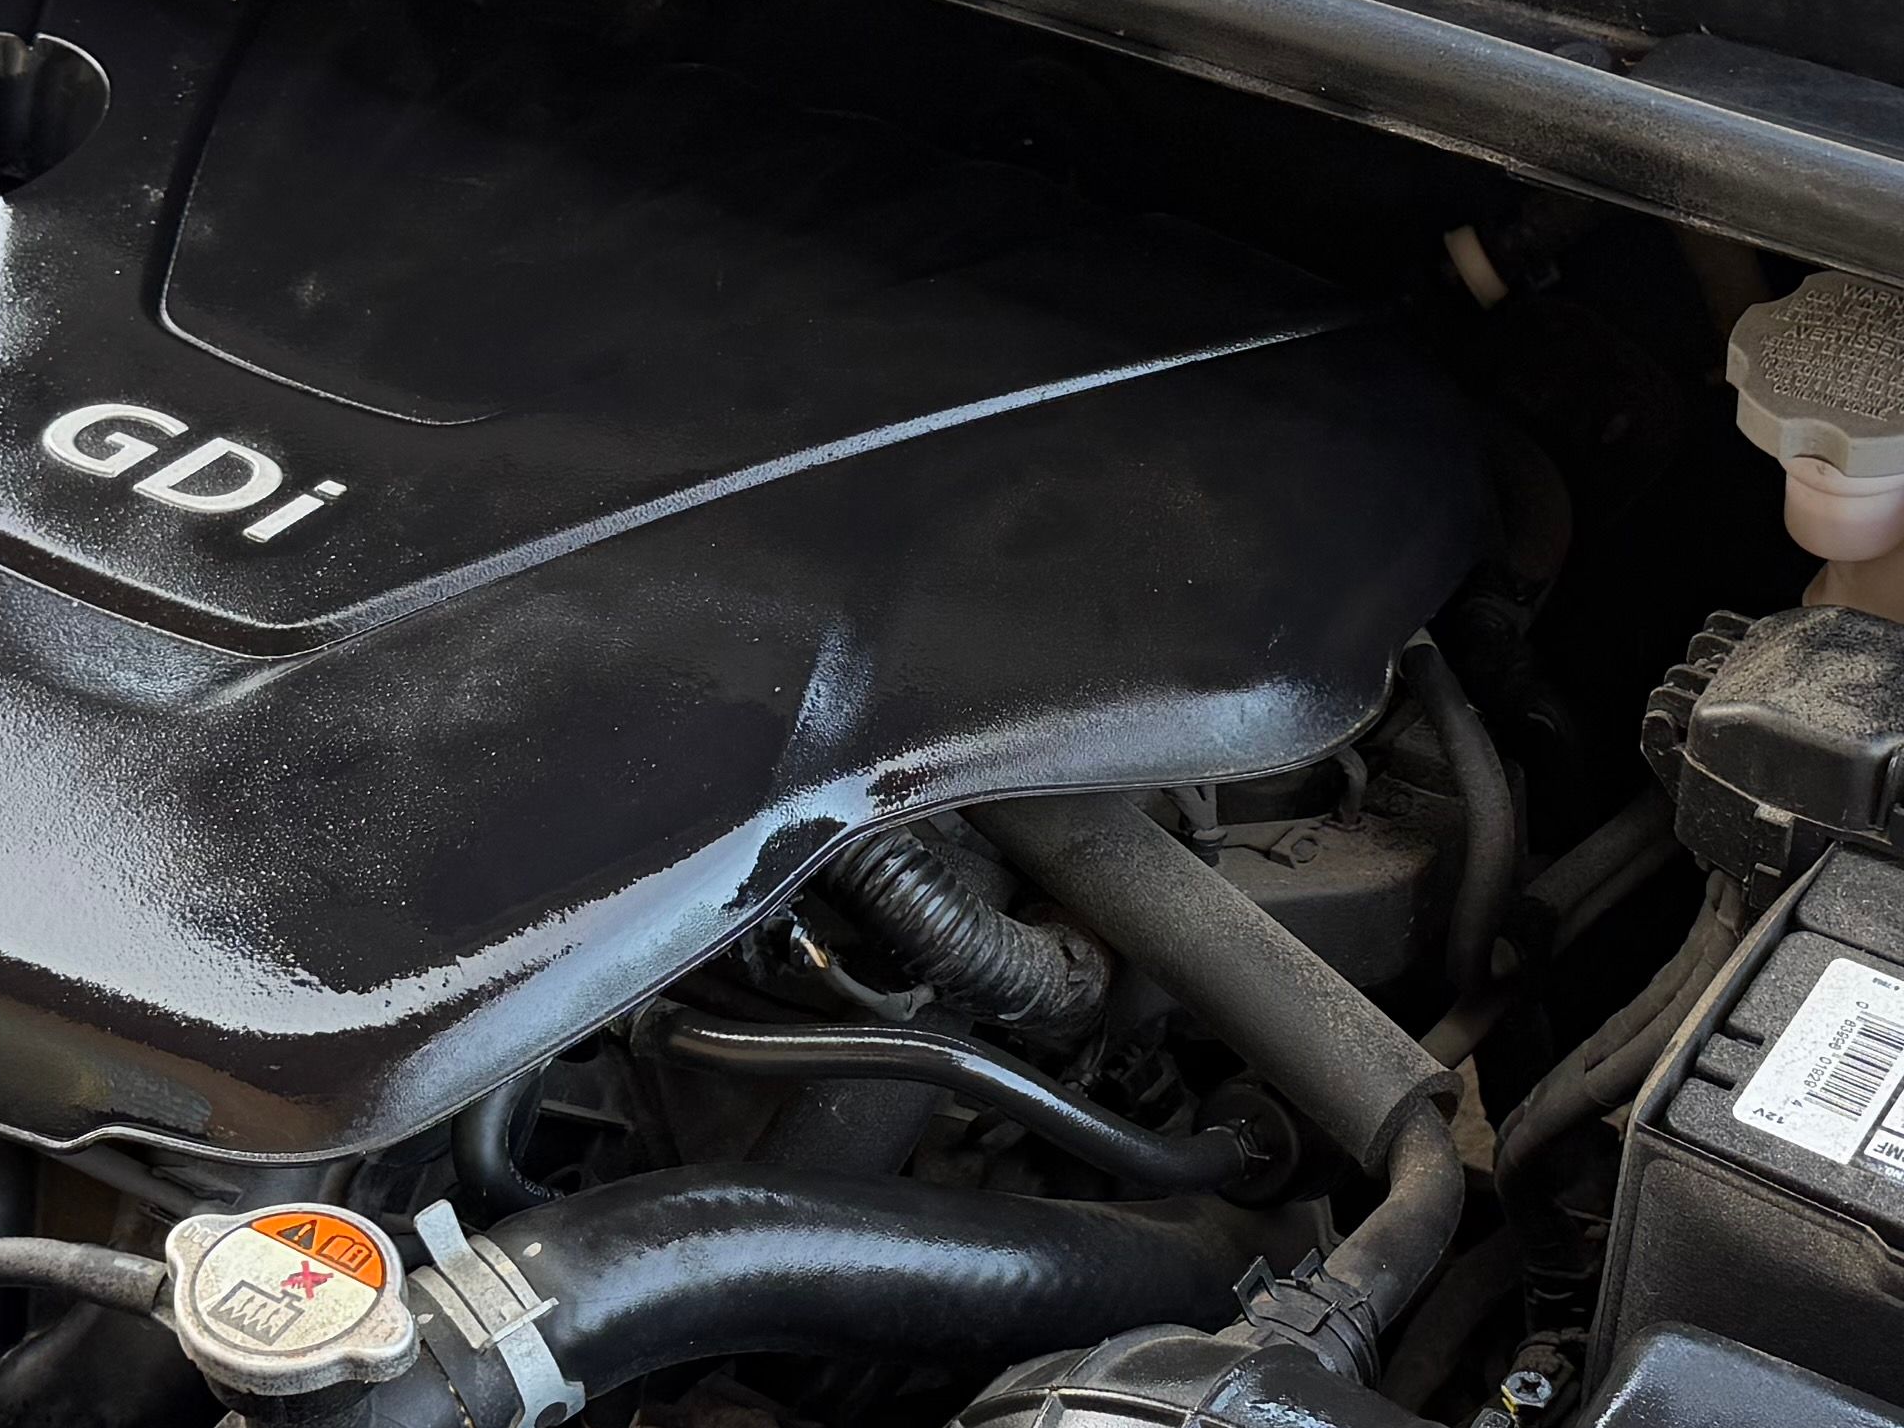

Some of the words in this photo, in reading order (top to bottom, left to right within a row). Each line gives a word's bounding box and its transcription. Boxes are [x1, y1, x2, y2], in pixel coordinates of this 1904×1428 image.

[42, 403, 348, 543] GDi
[1854, 999, 1869, 1009] 0
[1789, 1097, 1805, 1108] 4
[1751, 1105, 1786, 1125] 12V
